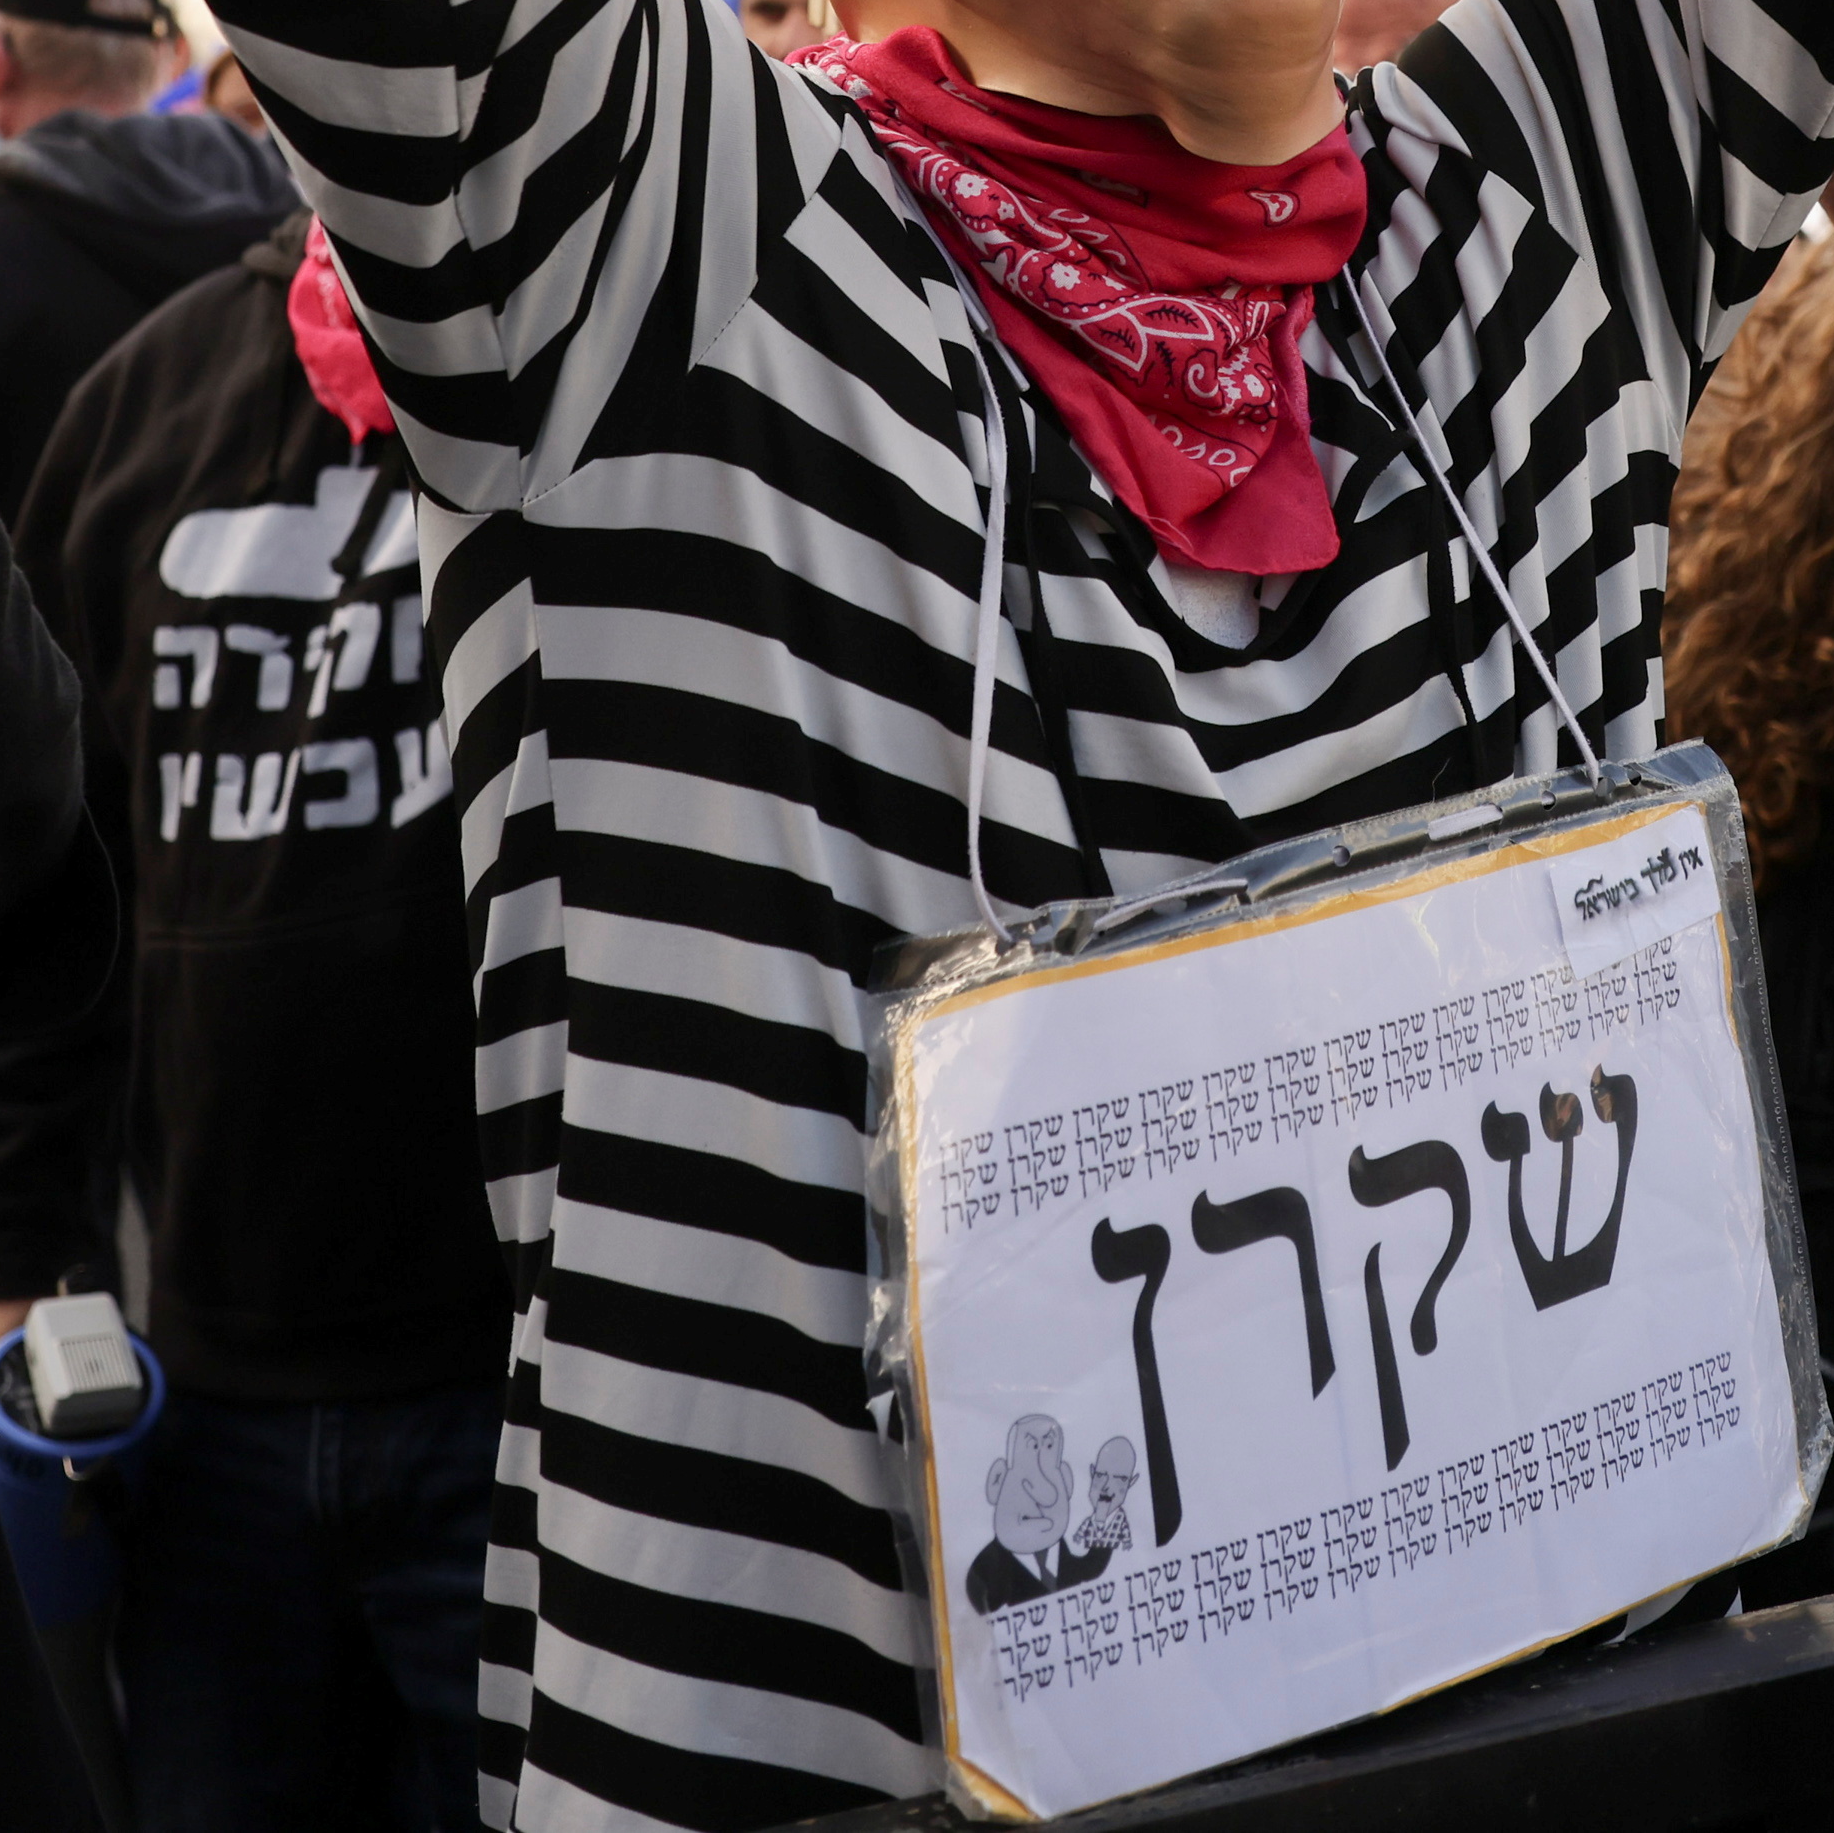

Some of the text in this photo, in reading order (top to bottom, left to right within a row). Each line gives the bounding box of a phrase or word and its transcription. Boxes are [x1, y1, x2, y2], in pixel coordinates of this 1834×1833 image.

[1678, 846, 1704, 880] אין
[1482, 980, 1524, 1018] שקרן
[1584, 976, 1626, 1013] שקרן
[1634, 961, 1676, 998] שקרן
[1379, 1012, 1425, 1051] שקרן
[1433, 996, 1474, 1034] שקרן
[1486, 1008, 1528, 1046] שקרן
[1535, 992, 1577, 1029] שקרן
[1324, 1029, 1371, 1068] שקרן
[1382, 1040, 1428, 1079] שקרן
[1436, 1024, 1478, 1062] שקרן
[1202, 1062, 1255, 1103] שקרן
[1264, 1046, 1315, 1086] שקרן
[1327, 1057, 1374, 1097] שקרן
[942, 988, 1680, 1233] שקרן שקרן שקרן שקרן שקרן שקרן שקרן שקרן שקרן שקרן שקרן שקרן שקרן
[1139, 1079, 1193, 1121] שקרן
[1206, 1091, 1258, 1132] שקרן
[1268, 1075, 1320, 1114] שקרן
[1004, 1115, 1063, 1156] שקרן
[1073, 1097, 1129, 1138] שקרן
[1141, 1108, 1196, 1150] שקרן
[1008, 1144, 1066, 1186] שקרן
[1075, 1126, 1132, 1168] שקרן
[941, 1162, 997, 1202] שקרן
[1092, 1062, 1638, 1547] שקרן
[1642, 1371, 1682, 1412] שקרן
[1689, 1352, 1730, 1392] שקרן
[1593, 1391, 1635, 1433] שקרן
[1646, 1398, 1686, 1440] שקרן
[1693, 1379, 1735, 1419] שקרן
[1541, 1412, 1586, 1454] שקרן
[1597, 1419, 1639, 1461] שקרן
[1650, 1426, 1690, 1467] שקרן
[1697, 1406, 1740, 1447] שקרן
[1491, 1432, 1534, 1475] שקרן
[1546, 1439, 1590, 1482] שקרן
[1601, 1447, 1643, 1489] שקרן
[1381, 1475, 1429, 1518] שקרן
[1438, 1454, 1484, 1497] שקרן
[1495, 1461, 1539, 1504] שקרן
[1551, 1468, 1594, 1511] שקרן
[1320, 1497, 1373, 1540] שקרן
[1441, 1482, 1488, 1526] שקרן
[1499, 1489, 1543, 1533] שקרן
[1257, 1518, 1311, 1561] שקרן
[1384, 1504, 1433, 1548] שקרן
[1445, 1511, 1491, 1554] שקרן
[1191, 1538, 1247, 1582] שקרן
[1260, 1547, 1315, 1591] שקרן
[1324, 1526, 1376, 1570] שקרן
[1388, 1533, 1436, 1577] שקרן
[1125, 1559, 1181, 1604] שקרן
[1194, 1568, 1251, 1612] שקרן
[1327, 1556, 1380, 1599] שקרן
[1058, 1581, 1115, 1626] שקרן
[1128, 1589, 1184, 1634] שקרן
[1264, 1577, 1318, 1621] שקרן
[1061, 1612, 1118, 1657] שקרן
[1198, 1598, 1254, 1643] שקרן
[1132, 1619, 1188, 1665] שקרן
[1064, 1642, 1123, 1687] שקרן
